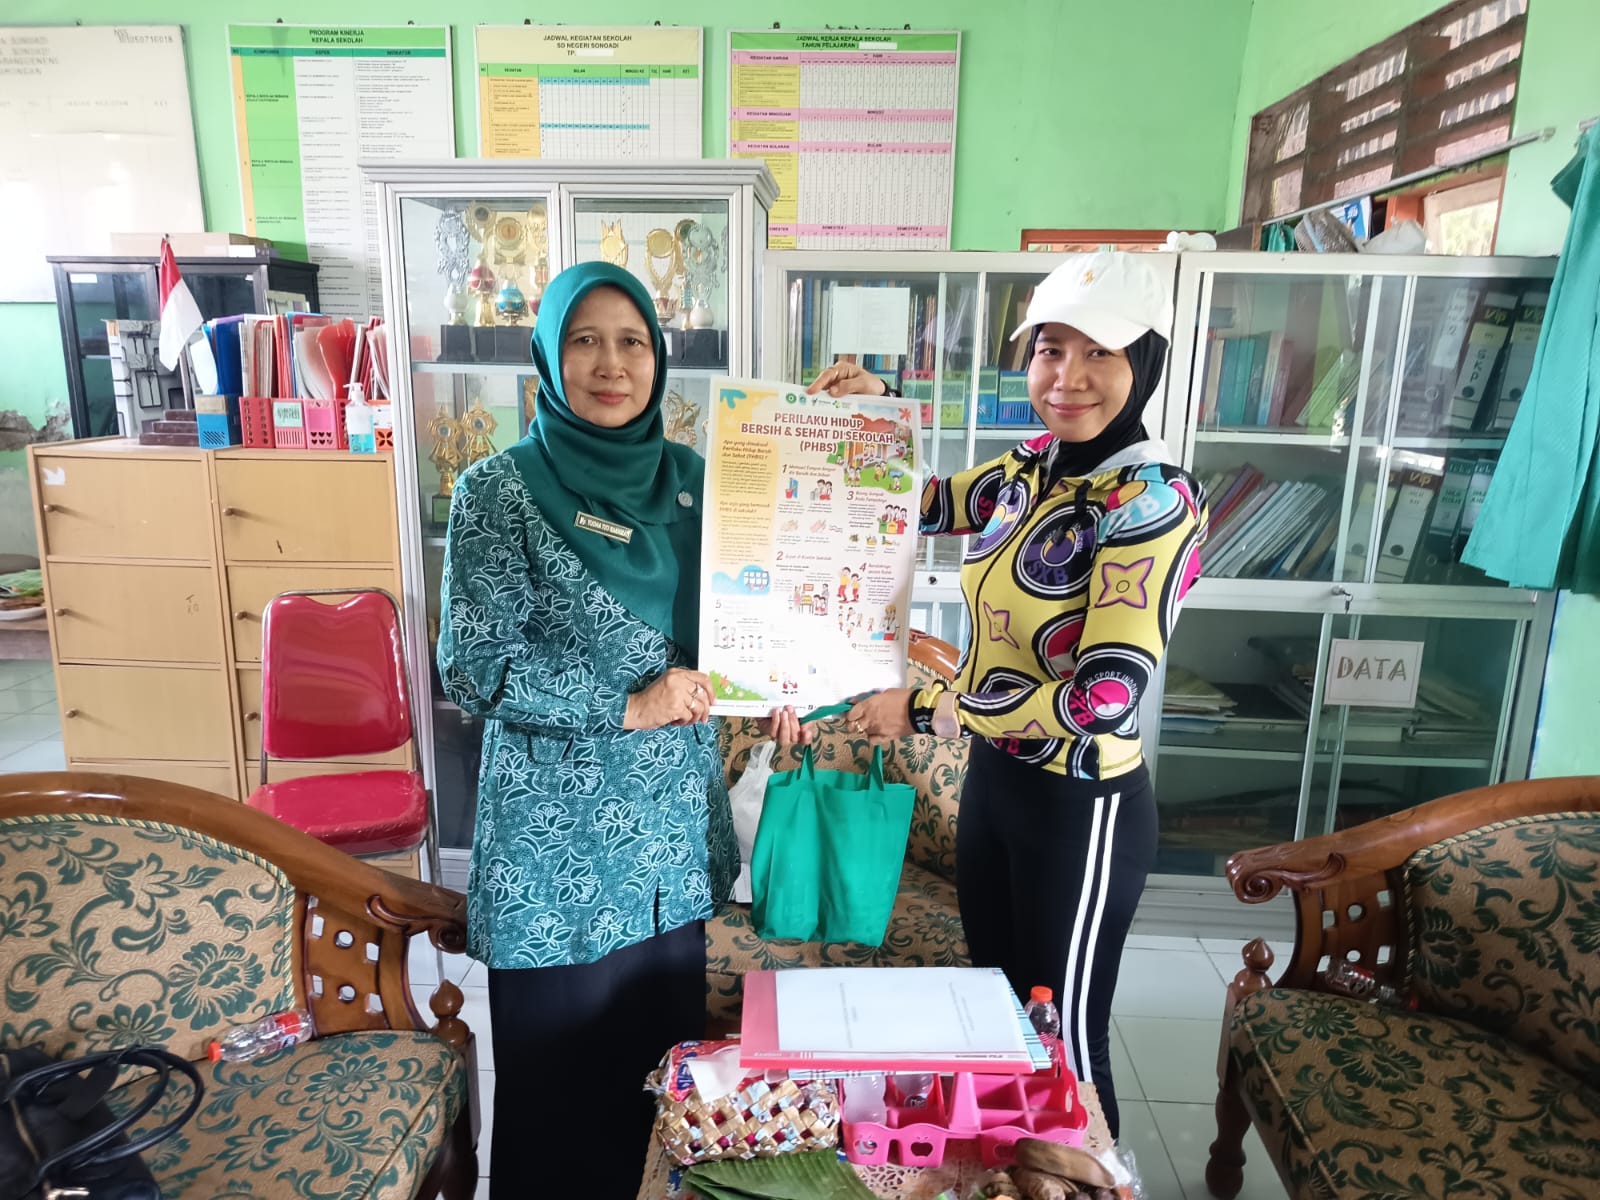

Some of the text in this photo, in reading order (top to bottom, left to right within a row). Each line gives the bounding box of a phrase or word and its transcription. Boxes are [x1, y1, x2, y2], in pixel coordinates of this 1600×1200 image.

[774, 412, 864, 429] PERILAKU HIDUP
[741, 423, 894, 444] BERSIH & SEHAT DI SEKOLAH
[800, 440, 837, 454] (PHBS)
[1408, 471, 1432, 487] Vip
[846, 490, 854, 501] 3
[776, 551, 784, 561] 2
[859, 563, 867, 572] 4
[1027, 560, 1069, 585] SXB
[1094, 670, 1122, 681] SPORT
[1337, 656, 1407, 681] DATA
